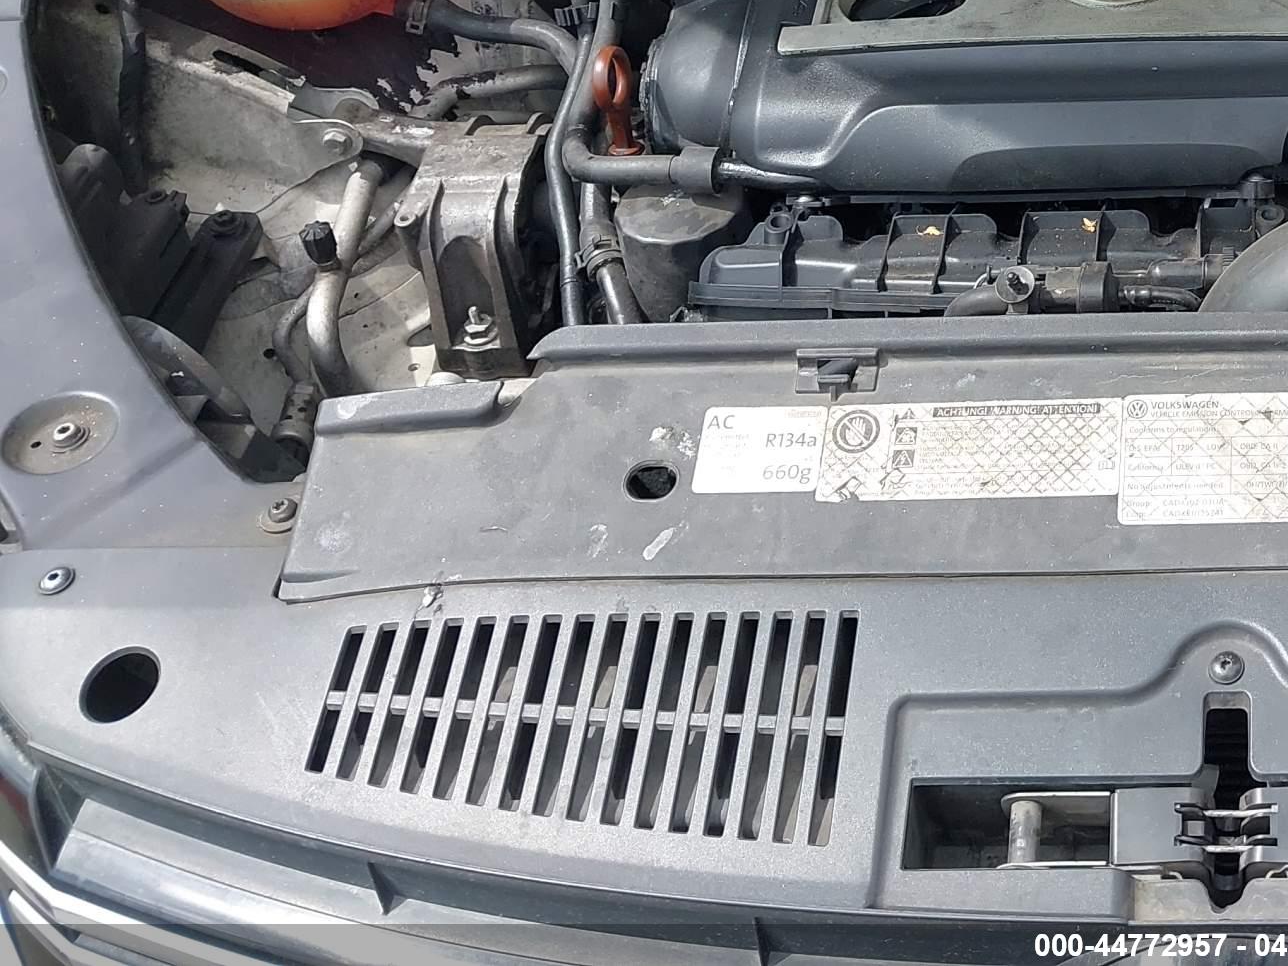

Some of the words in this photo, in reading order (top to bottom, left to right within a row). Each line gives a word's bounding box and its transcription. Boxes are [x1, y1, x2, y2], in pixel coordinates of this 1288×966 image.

[1151, 401, 1219, 410] VOLKSWAGEN
[707, 414, 735, 429] AC
[765, 433, 817, 448] R134a
[762, 464, 812, 485] 660g
